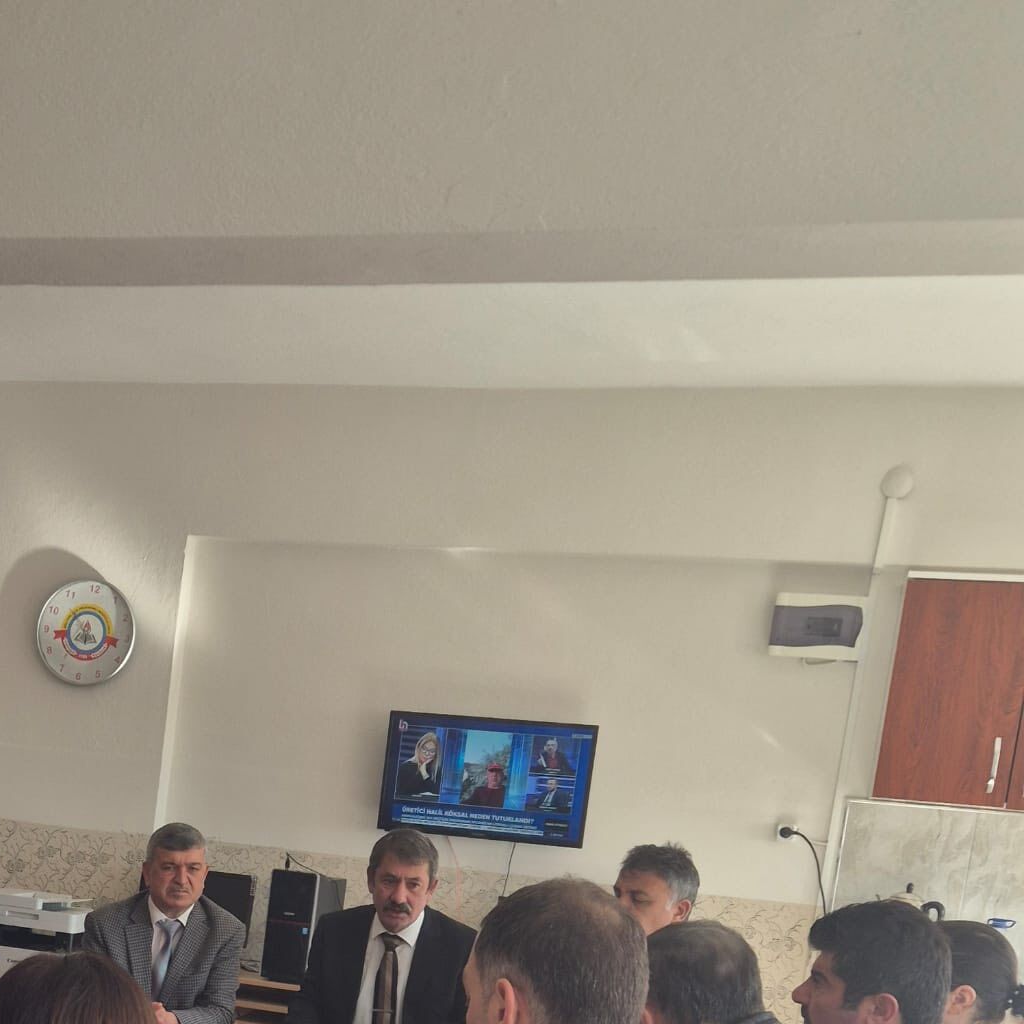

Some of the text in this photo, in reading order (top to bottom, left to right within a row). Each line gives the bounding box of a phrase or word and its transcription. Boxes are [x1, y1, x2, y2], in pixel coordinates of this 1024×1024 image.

[90, 584, 100, 593] 12
[66, 590, 75, 599] 11
[49, 606, 59, 614] 10
[44, 625, 49, 633] 9
[47, 646, 52, 655] 8
[114, 656, 121, 664] 4
[59, 664, 64, 672] 7
[76, 672, 81, 680] 6
[96, 670, 101, 678] 5
[470, 812, 490, 820] NEDEN
